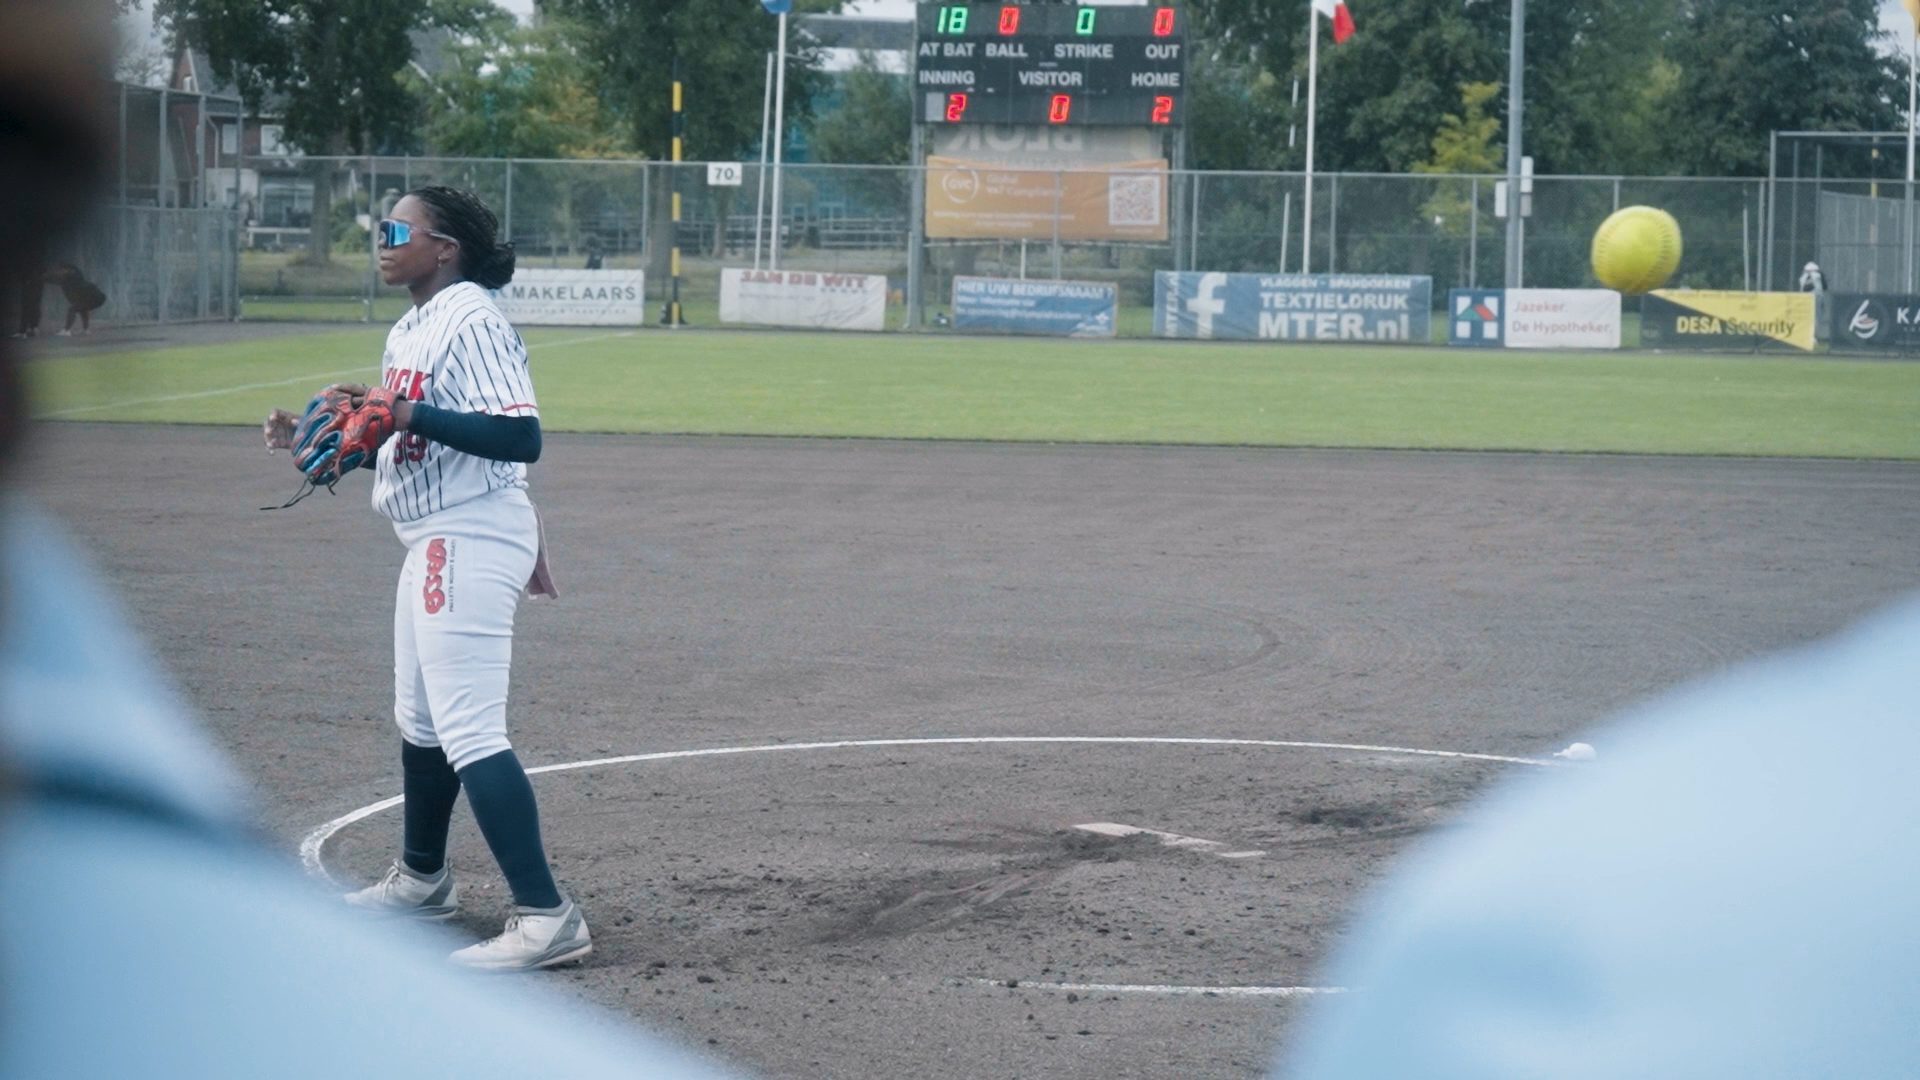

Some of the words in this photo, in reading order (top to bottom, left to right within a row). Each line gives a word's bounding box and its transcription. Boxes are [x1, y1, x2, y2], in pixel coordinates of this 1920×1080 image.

[938, 7, 968, 33] 18
[999, 7, 1020, 35] 0
[1076, 8, 1096, 35] 0
[1154, 8, 1175, 36] 0
[919, 43, 942, 57] AT
[944, 43, 976, 57] BAT
[986, 43, 1028, 57] BALL
[1054, 44, 1114, 58] STRIKE
[1145, 44, 1180, 58] OUT
[919, 71, 975, 85] INNING
[1018, 71, 1083, 86] VISITOR
[1131, 73, 1180, 87] HOME
[947, 93, 967, 121] 2
[1050, 95, 1070, 123] 0
[1152, 95, 1173, 123] 2
[714, 167, 735, 180] 70
[822, 273, 868, 288] WIT
[1259, 292, 1409, 310] TEXTIELDRUK
[1258, 311, 1409, 340] MTER.nl
[1676, 315, 1722, 334] DESA
[1725, 317, 1796, 338] Security
